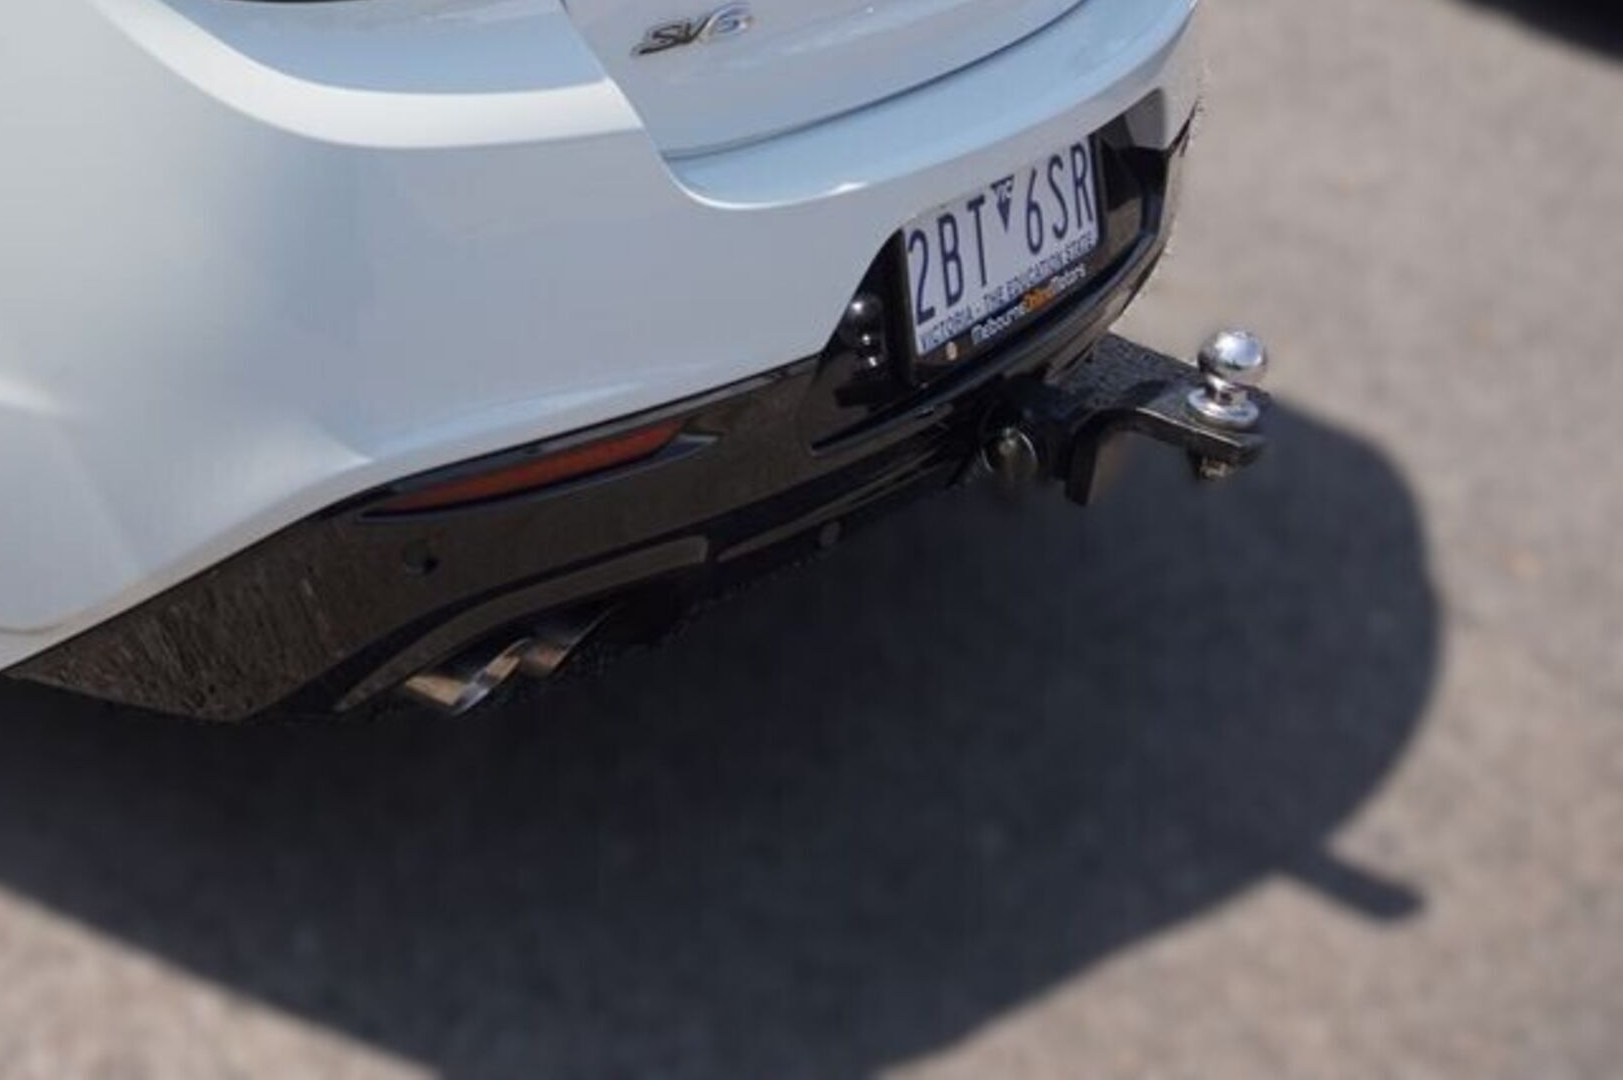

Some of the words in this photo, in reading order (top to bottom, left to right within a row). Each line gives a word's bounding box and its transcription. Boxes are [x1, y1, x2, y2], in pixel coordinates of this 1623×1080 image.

[629, 0, 754, 56] SV6
[907, 194, 988, 325] 2BT
[1026, 142, 1094, 255] 6SR
